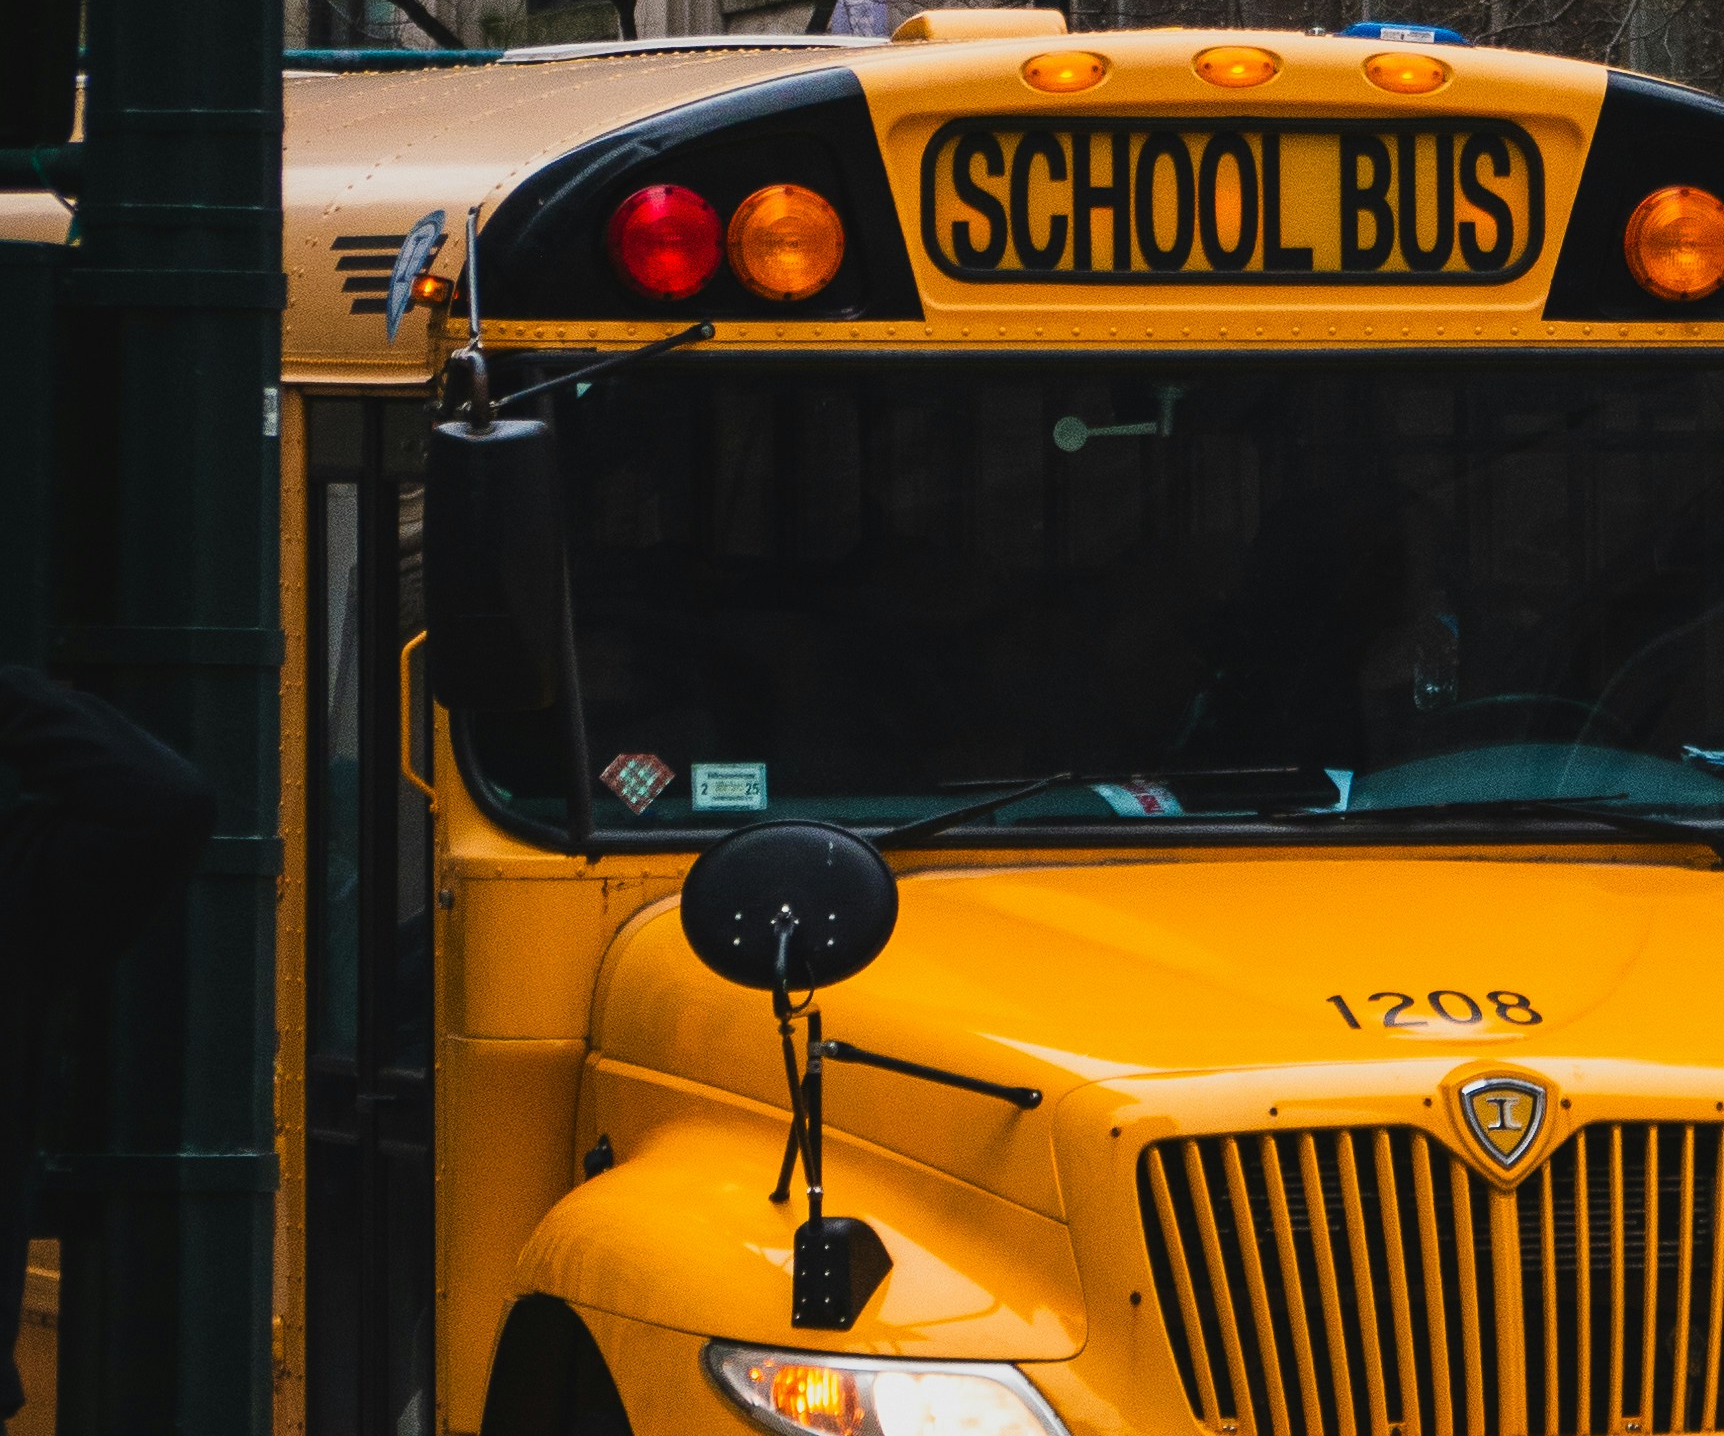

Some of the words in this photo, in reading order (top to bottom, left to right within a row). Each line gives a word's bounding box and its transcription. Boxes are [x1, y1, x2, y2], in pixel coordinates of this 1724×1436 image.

[951, 130, 1313, 272] SCHOOL
[1340, 132, 1516, 272] BUS
[1326, 990, 1543, 1029] 1208
